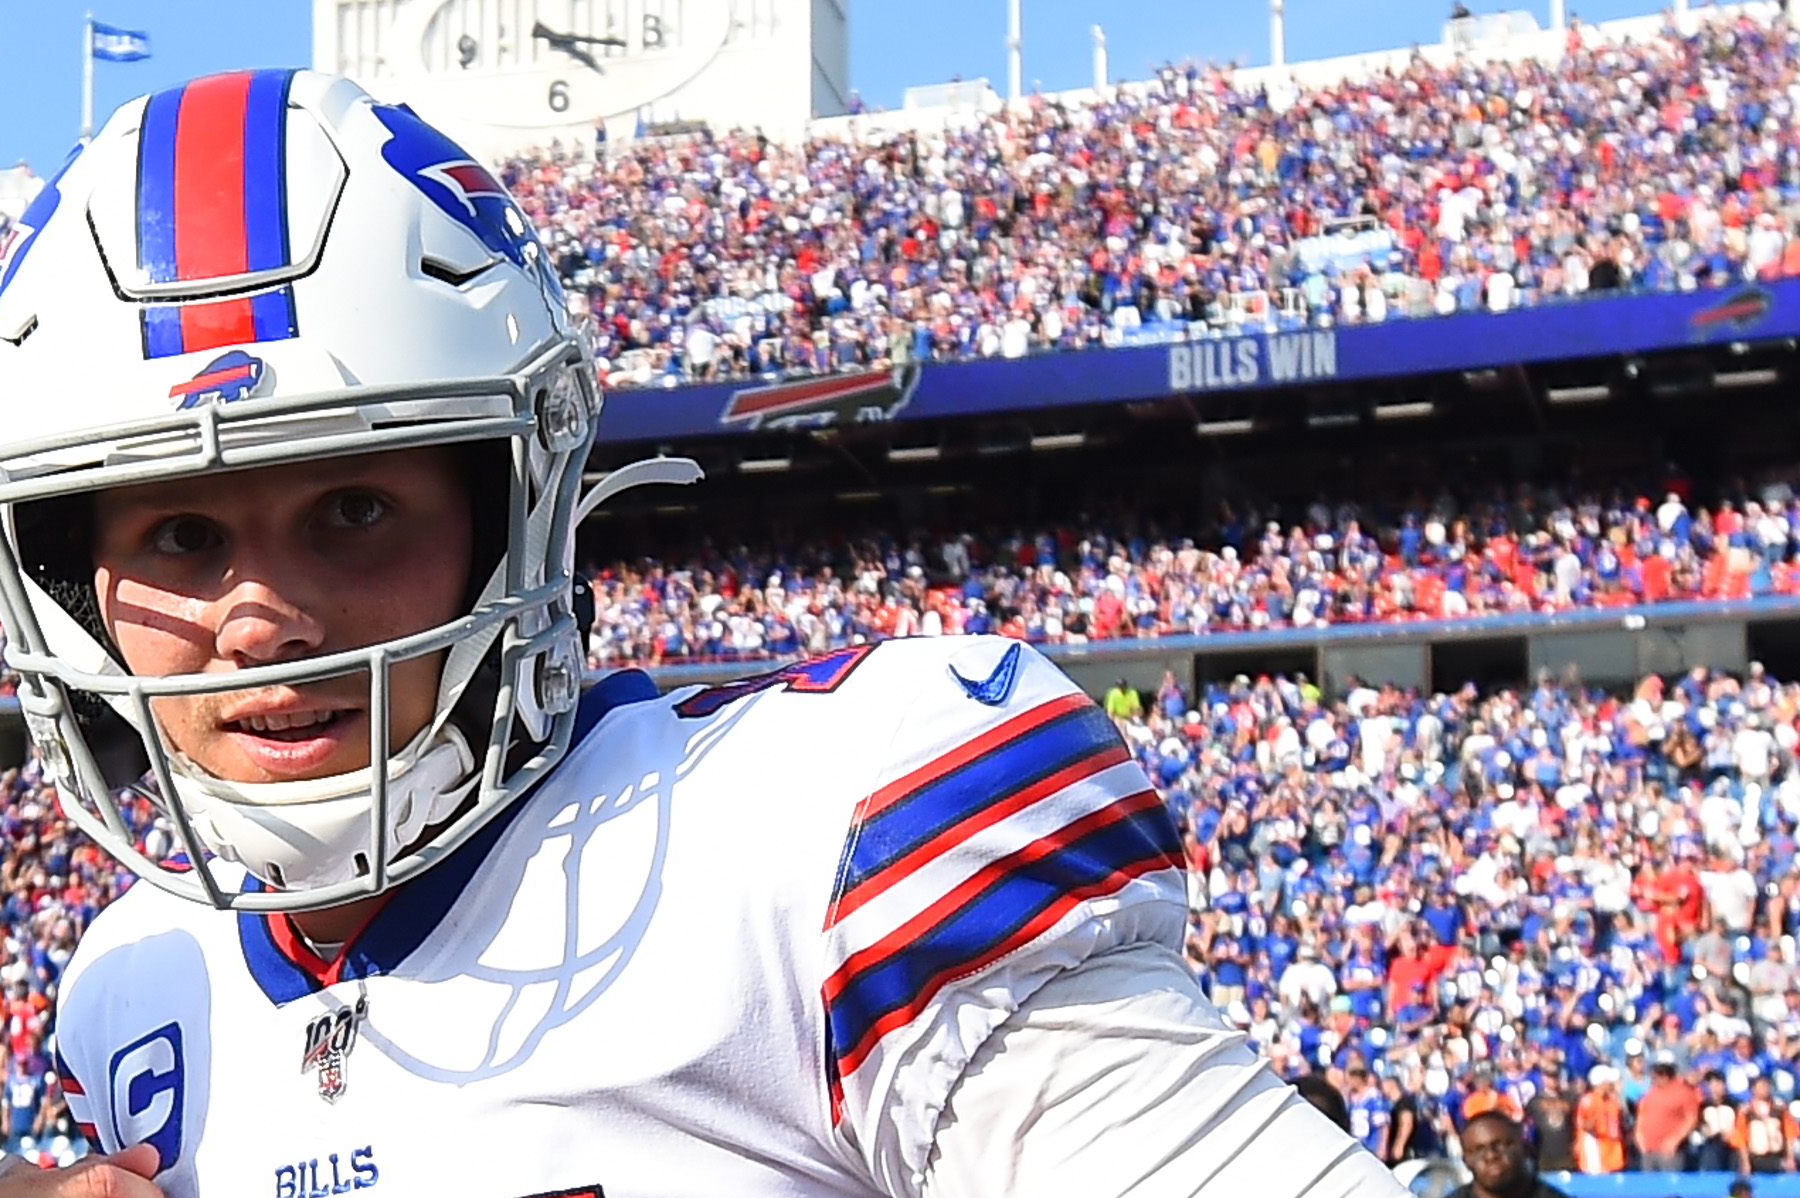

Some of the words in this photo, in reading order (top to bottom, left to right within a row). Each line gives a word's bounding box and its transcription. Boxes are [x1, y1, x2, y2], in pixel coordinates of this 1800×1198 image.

[548, 79, 570, 112] 6
[1170, 338, 1259, 389] BILLS
[1267, 330, 1336, 380] WIN
[114, 1036, 175, 1146] C
